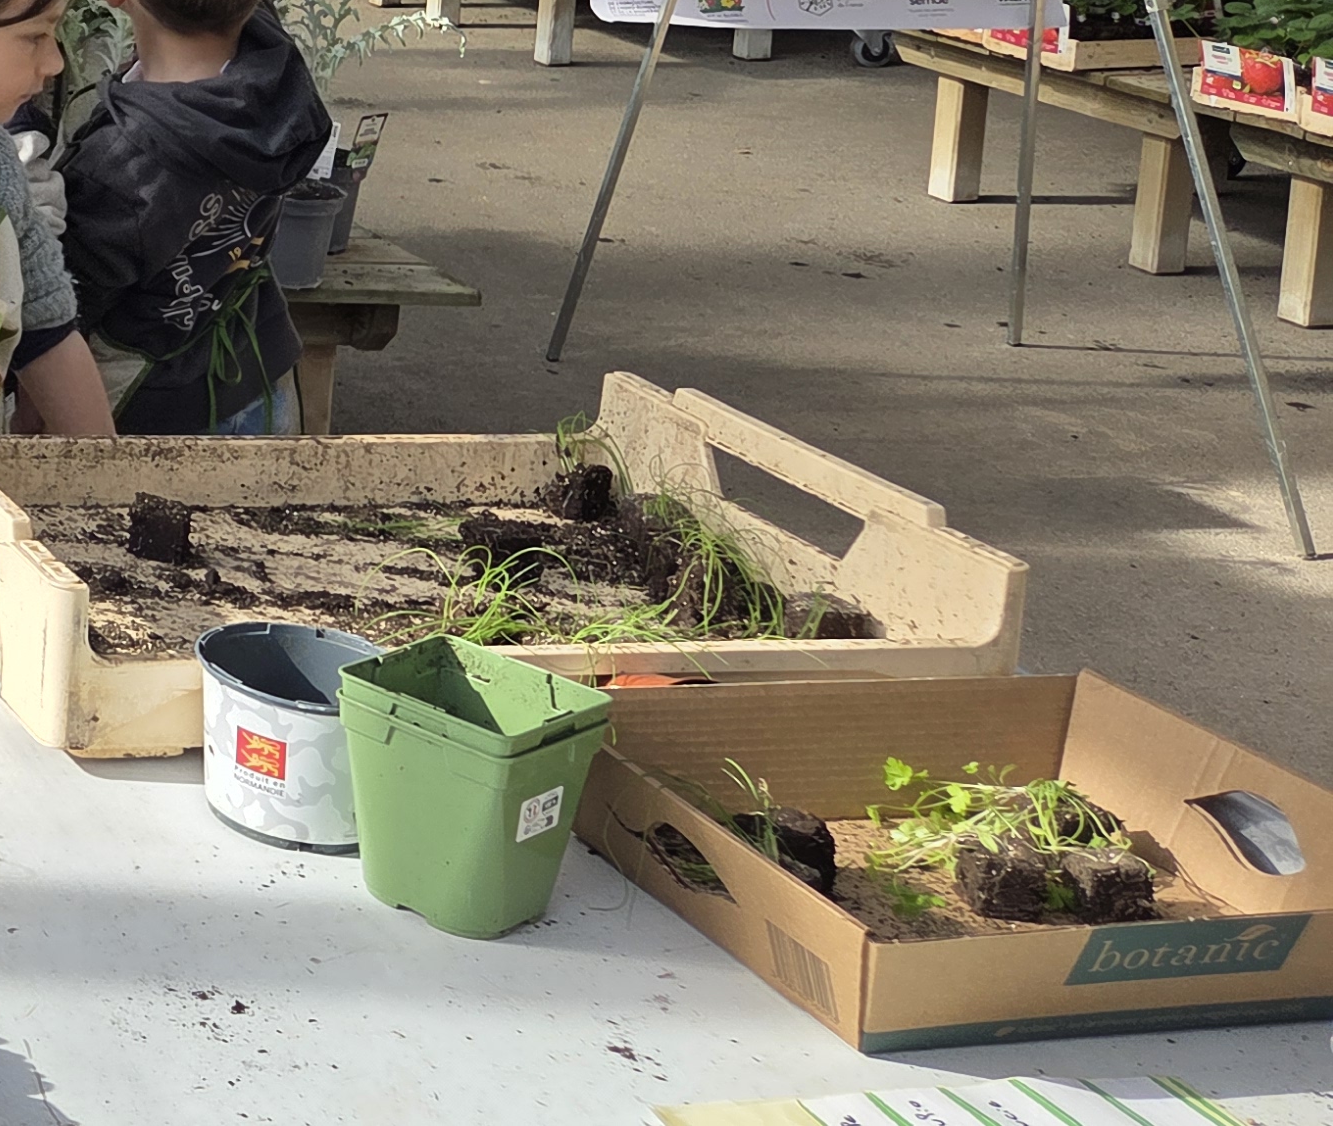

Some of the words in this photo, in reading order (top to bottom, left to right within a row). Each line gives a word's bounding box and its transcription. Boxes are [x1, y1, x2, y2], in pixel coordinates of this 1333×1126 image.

[233, 772, 285, 797] NORMANDIE
[273, 780, 286, 789] en
[1088, 937, 1280, 973] botanic
